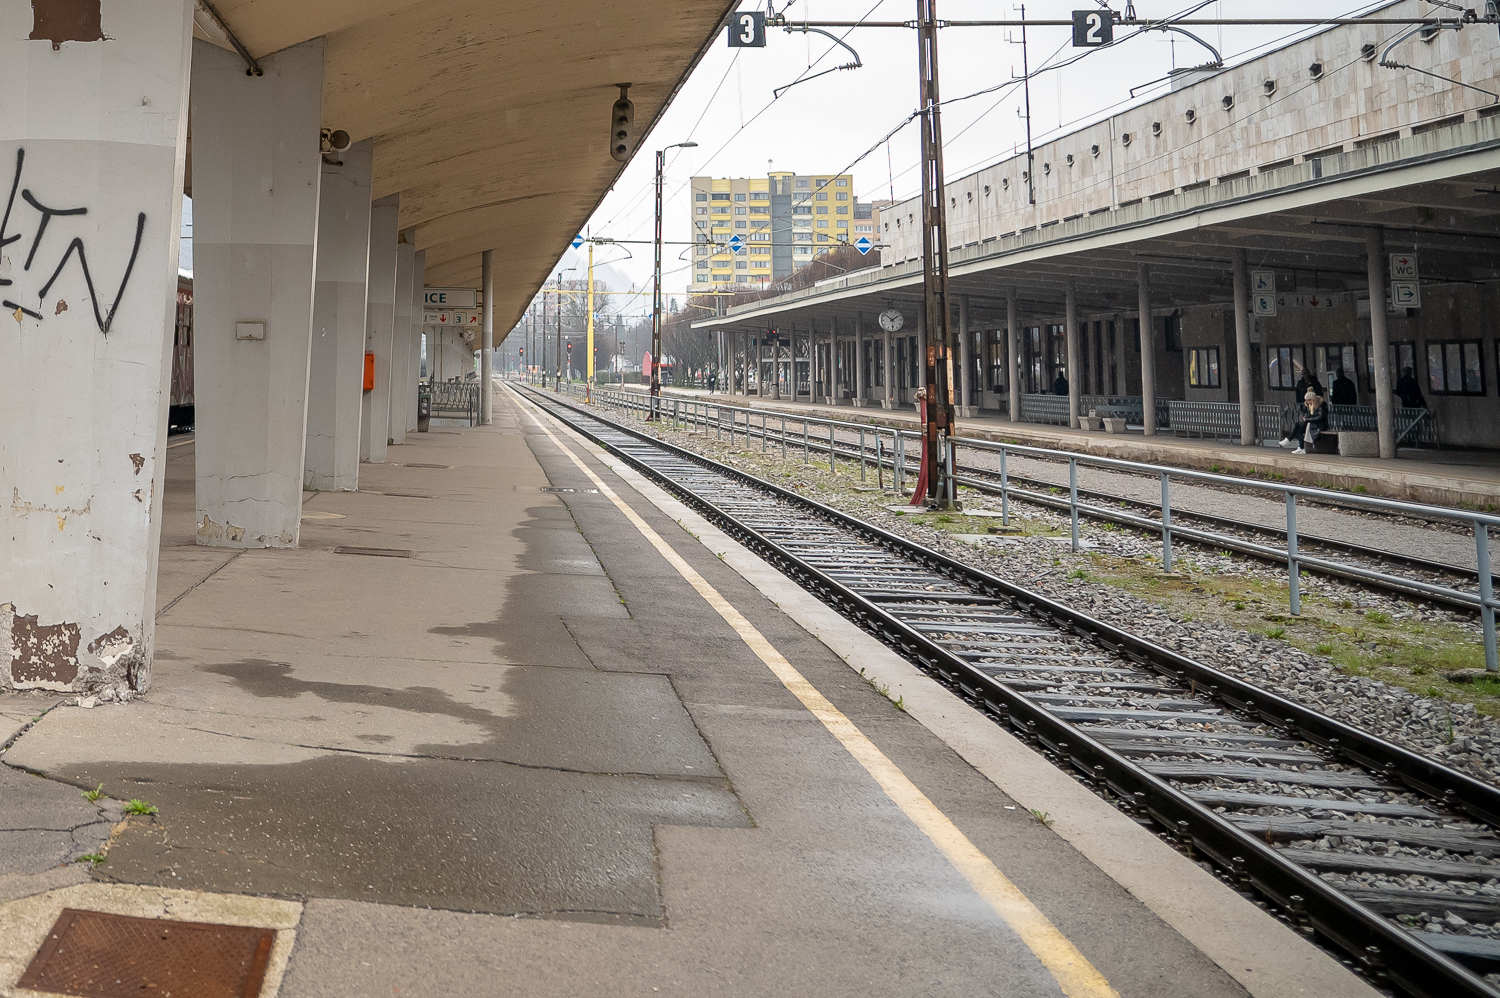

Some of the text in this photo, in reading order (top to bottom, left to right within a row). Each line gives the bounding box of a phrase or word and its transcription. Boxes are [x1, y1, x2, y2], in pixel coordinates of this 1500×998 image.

[739, 14, 755, 44] 3
[1085, 12, 1102, 43] 2
[1395, 266, 1413, 275] WC
[455, 315, 462, 324] 3
